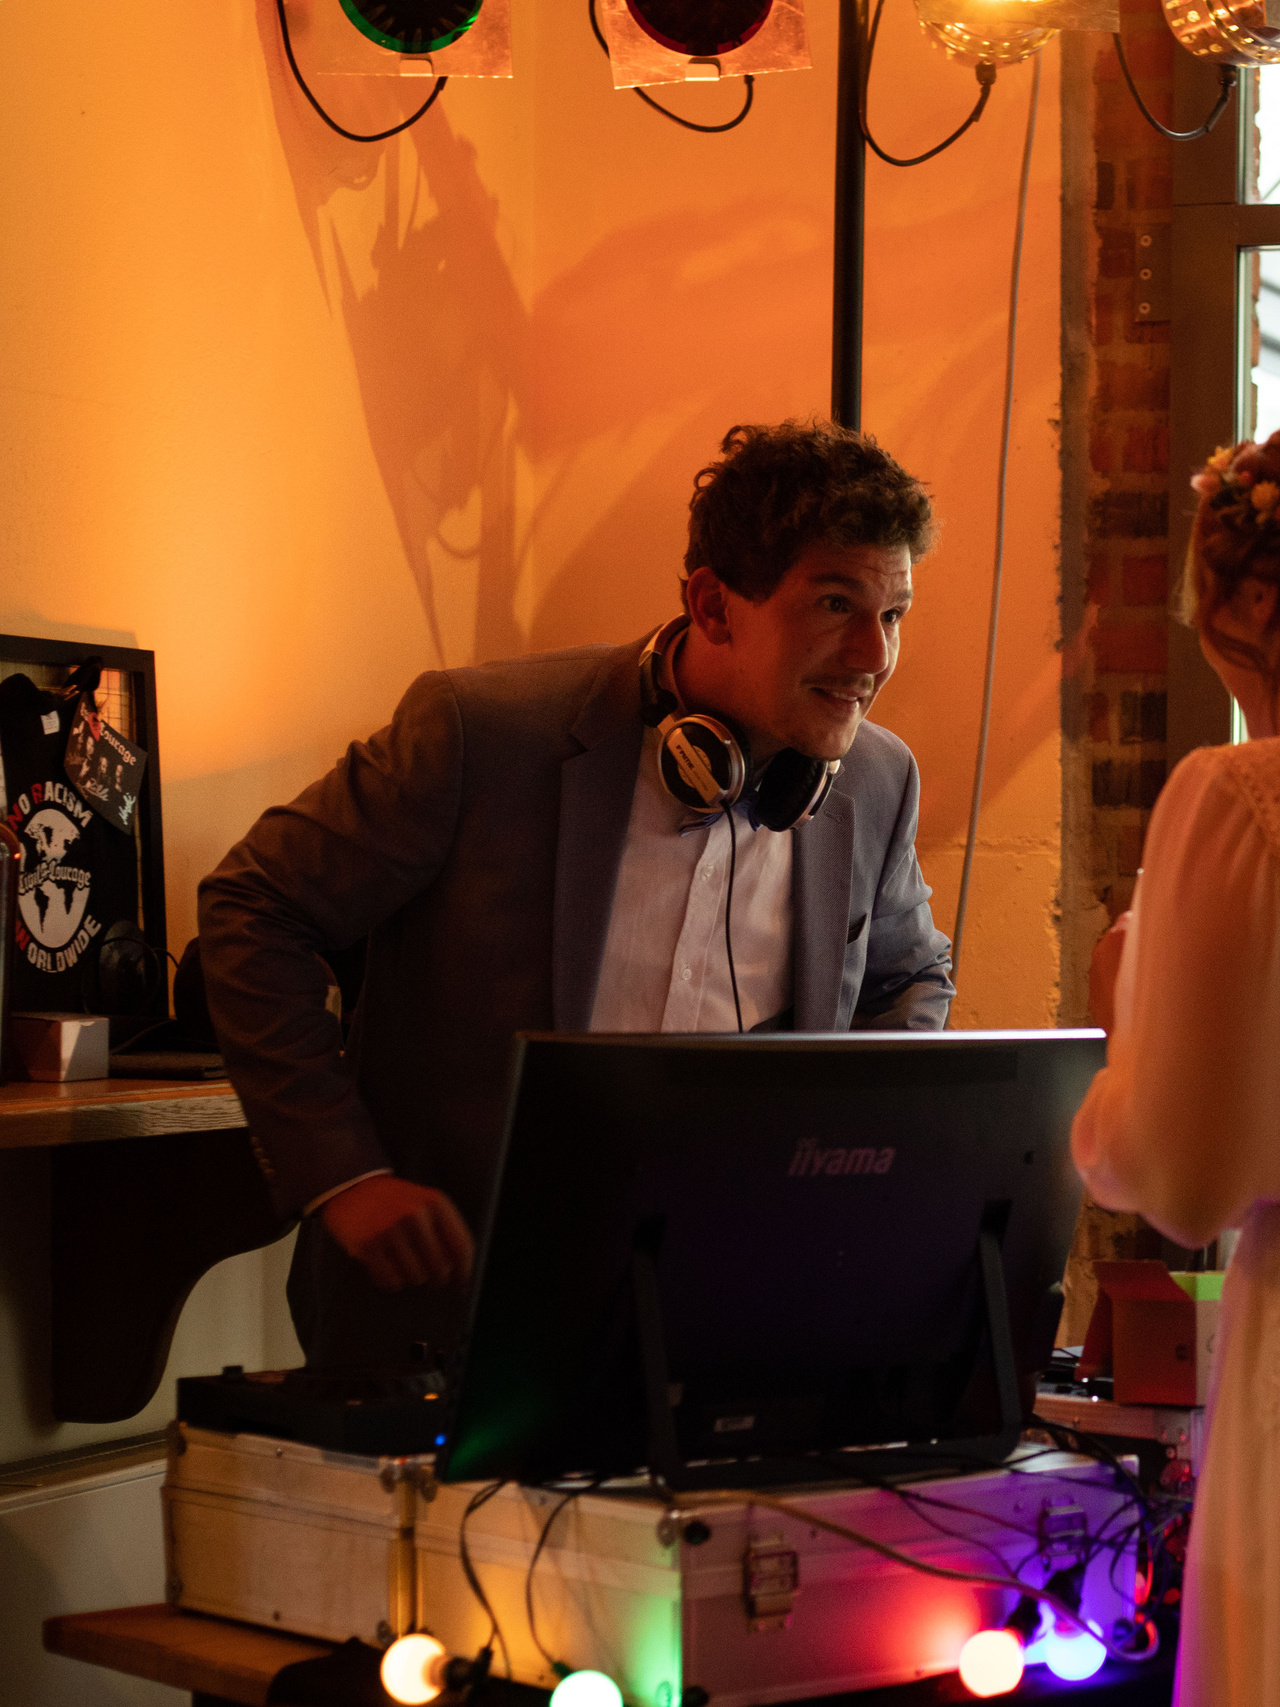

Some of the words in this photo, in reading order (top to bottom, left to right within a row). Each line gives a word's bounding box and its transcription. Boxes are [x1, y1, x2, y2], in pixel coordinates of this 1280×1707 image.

[7, 793, 31, 831] NO
[31, 781, 93, 828] RACISM
[15, 915, 102, 973] WORLDWIDE
[788, 1137, 896, 1177] iiyama
